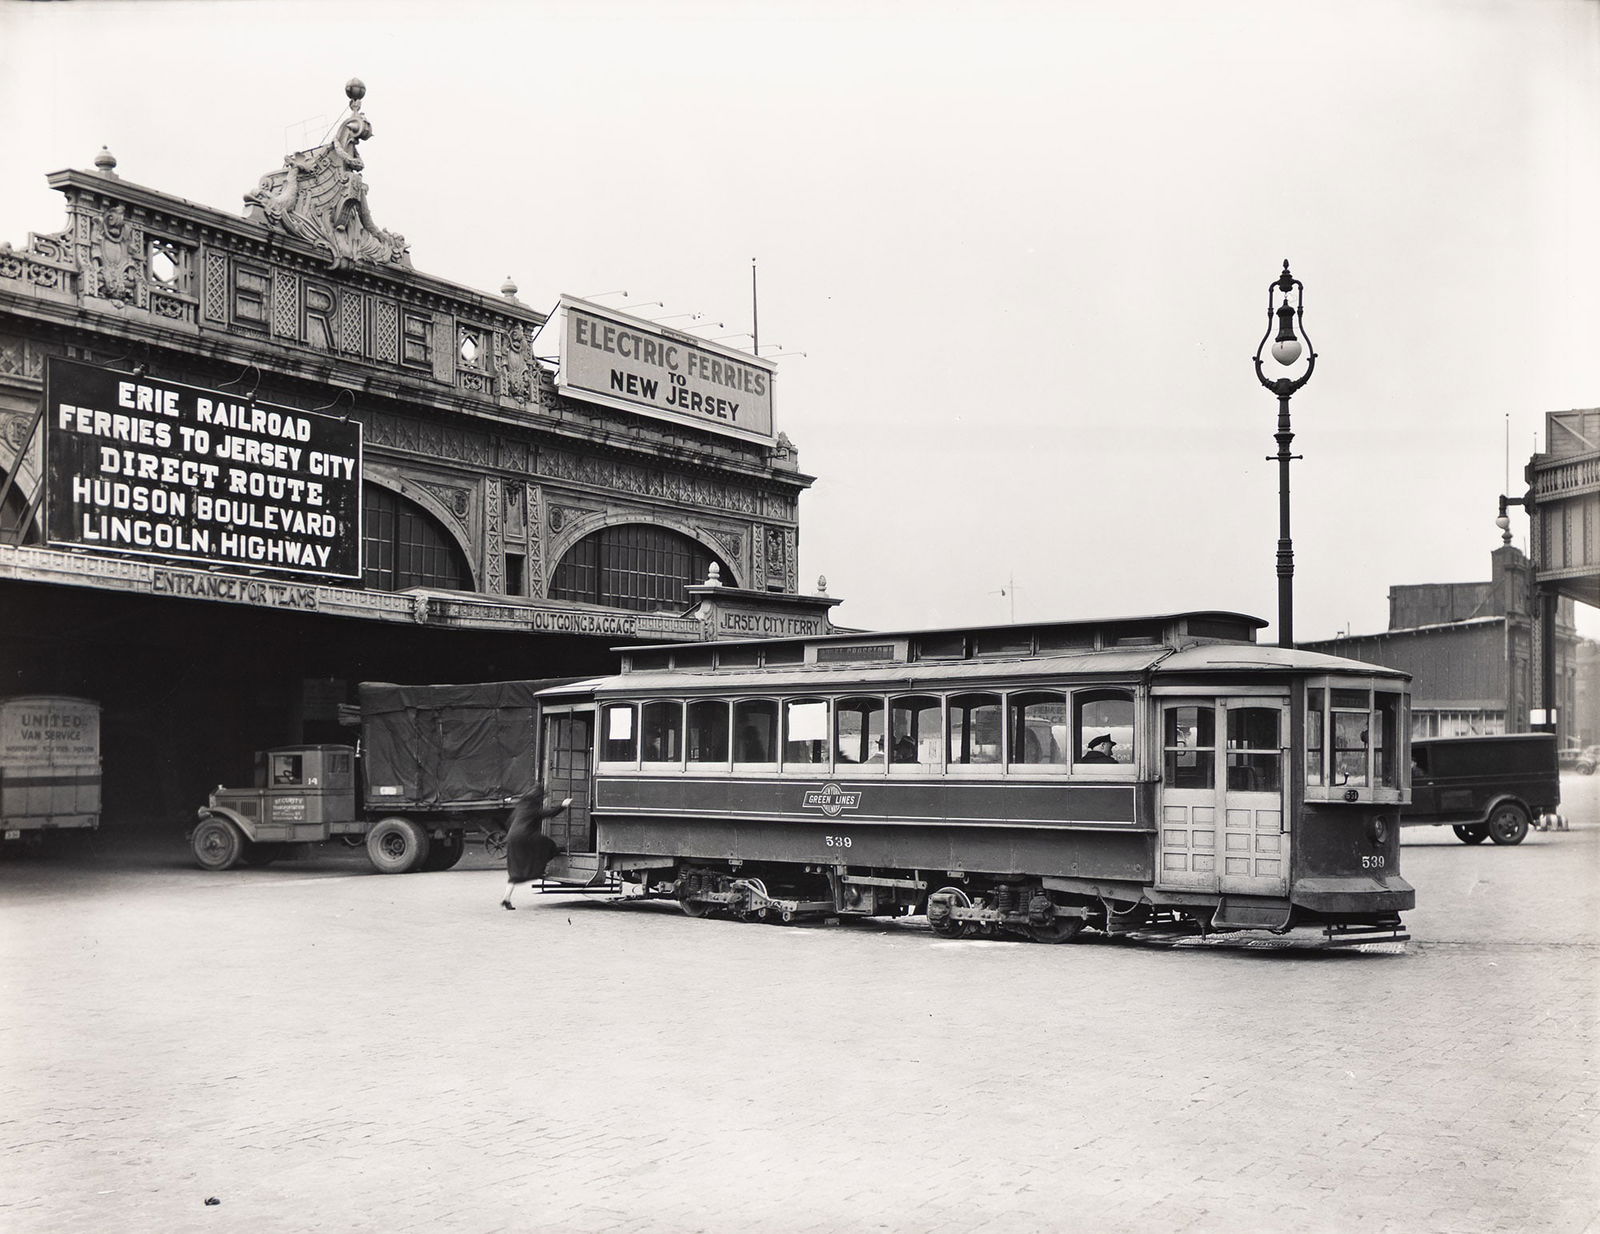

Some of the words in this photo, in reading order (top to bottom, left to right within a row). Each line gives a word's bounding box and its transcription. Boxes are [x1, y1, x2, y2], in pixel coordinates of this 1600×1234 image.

[230, 257, 433, 371] ERIE
[576, 317, 679, 371] ELECTRIC
[688, 352, 766, 396] FERRIES
[611, 369, 658, 400] NEW
[666, 386, 740, 421] JERSEY
[668, 372, 687, 386] TO
[118, 381, 180, 417] ERIE
[197, 398, 311, 442] RAILROAD
[59, 404, 171, 448] FERRIES
[180, 426, 210, 454] TO
[216, 435, 302, 471] JERSEY
[309, 452, 355, 480] CITY
[100, 446, 219, 488] DIRECT
[229, 468, 323, 506] ROUTE
[73, 477, 186, 517] HUDSON
[197, 496, 336, 537] BOULEVARD
[83, 513, 209, 553] LINCOLN
[221, 532, 332, 567] HIGHWAY
[153, 570, 237, 599] ENTRANCE
[239, 582, 267, 603] FOR
[269, 585, 317, 608] TEAMS
[535, 612, 588, 631] OUTGOING
[588, 615, 636, 635] BAGGAGE
[720, 612, 762, 631] JERSEY
[763, 616, 785, 633] CITY
[787, 618, 819, 635] FERRY
[21, 729, 41, 740] VAN
[44, 730, 81, 741] SERVICE
[22, 714, 82, 728] UNITED
[808, 795, 831, 804] GREEN
[835, 796, 856, 805] LINES
[825, 836, 852, 848] 539
[1362, 855, 1385, 868] 539
